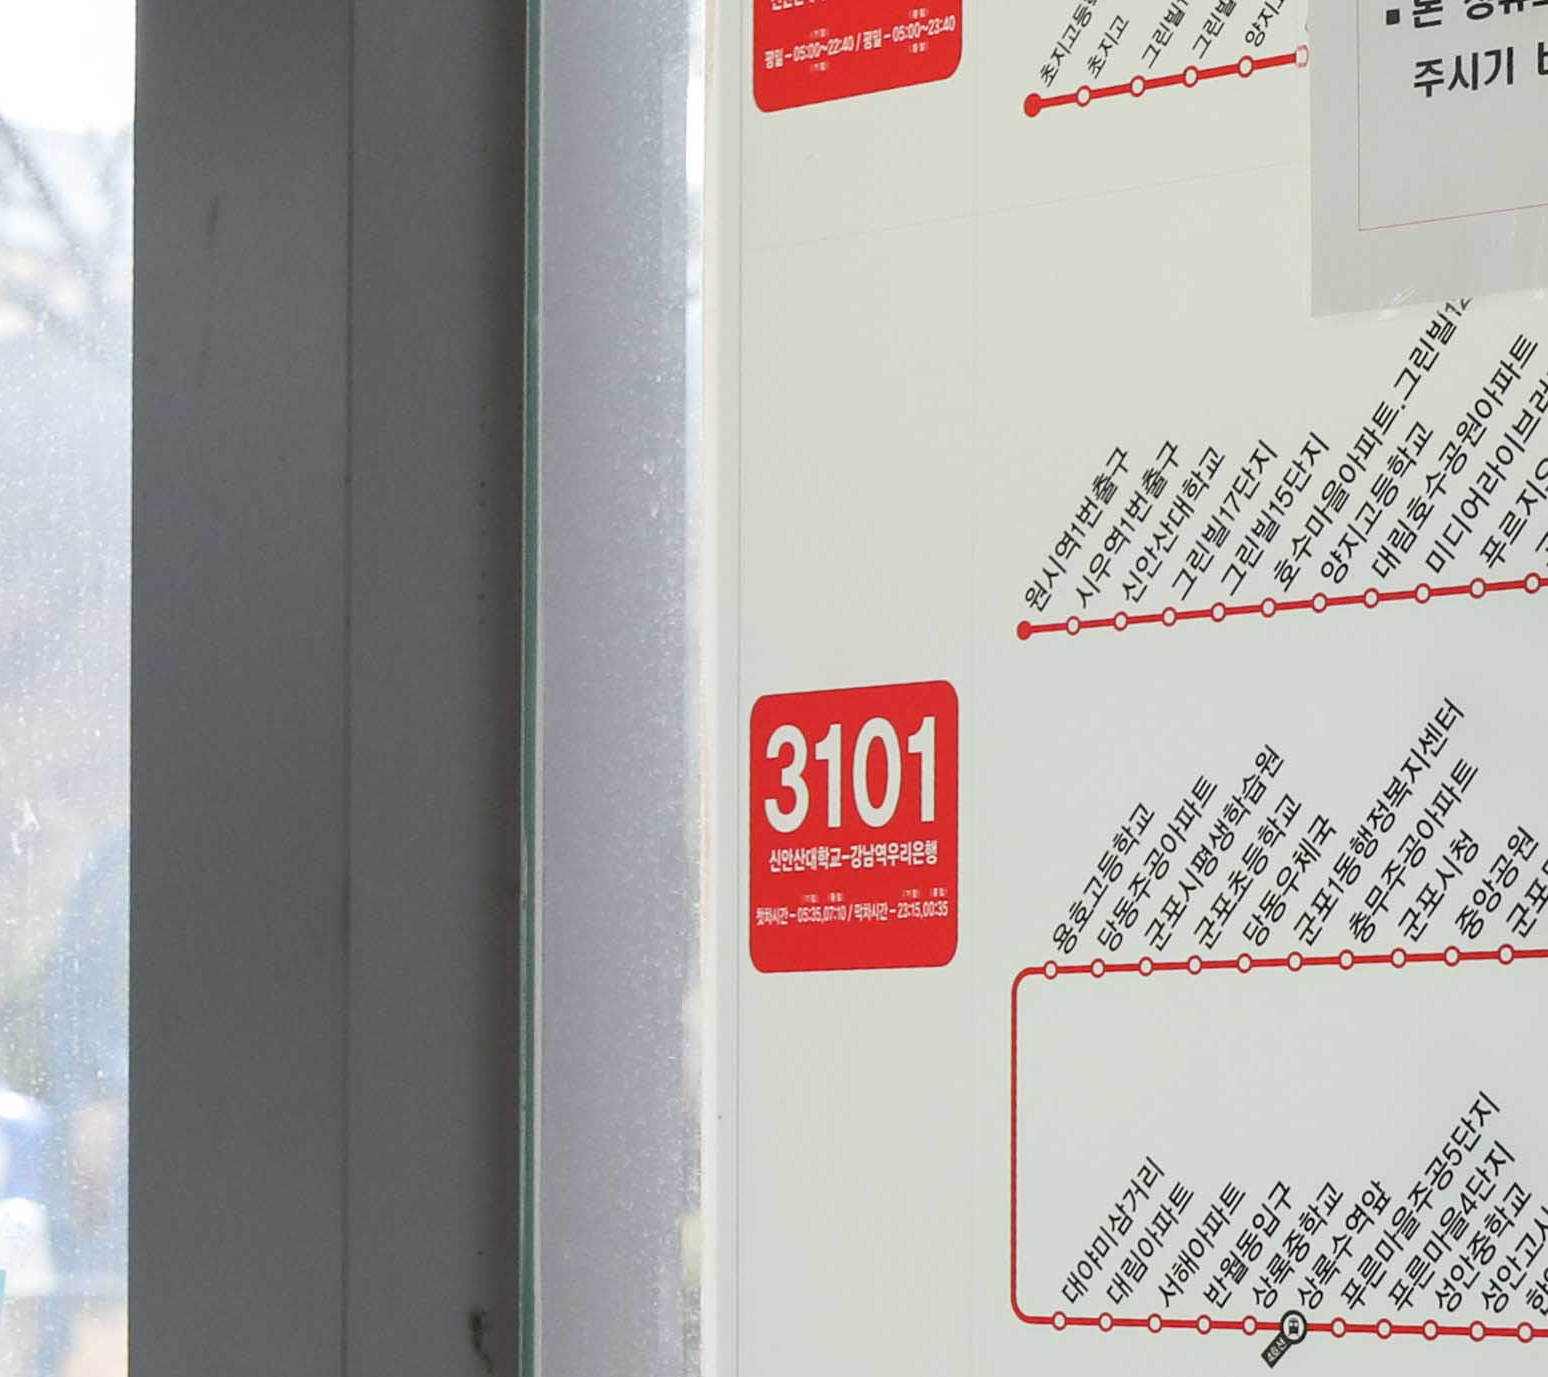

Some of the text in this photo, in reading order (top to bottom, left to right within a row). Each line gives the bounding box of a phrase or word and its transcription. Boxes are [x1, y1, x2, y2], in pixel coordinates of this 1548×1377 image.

[1088, 14, 1130, 80] 초지고
[1414, 47, 1513, 97] 주시기
[1025, 446, 1128, 612] 원시역1번출구
[1074, 440, 1179, 608] 시우역1번출구
[1121, 447, 1225, 604] 신안산대학교
[1173, 439, 1278, 601] 그린빌17단지
[1220, 431, 1330, 597] 그린빌15단지
[1320, 421, 1433, 586] 양지고등학교
[1371, 333, 1538, 580] 대림호수공원아파트
[764, 716, 936, 834] 3101
[1145, 744, 1284, 951] 군포시평생학습원
[1293, 697, 1464, 947] 군포1동행정복지센터
[1349, 758, 1478, 944] 충무주공아파트
[1052, 803, 1155, 955] 용호고등학교
[1096, 775, 1217, 953] 당동주공아파트
[1194, 793, 1302, 949] 군포초등학교
[1243, 814, 1336, 947] 당동우체국
[1398, 829, 1480, 942] 군포시청
[1454, 826, 1538, 940] 중앙공원
[1061, 1155, 1165, 1305] 대야미삼거리
[1106, 1181, 1195, 1306] 대림아파트
[1157, 1181, 1246, 1308] 서해아파트
[1203, 1181, 1292, 1309] 반월동입구
[1251, 1182, 1344, 1310] 상록중학교
[1295, 1180, 1391, 1310] 상록수역앞
[1340, 1091, 1500, 1311] 푸른마을주공5단지
[1388, 1140, 1516, 1313] 푸른마을4단지
[1433, 1182, 1532, 1314] 성안중학교
